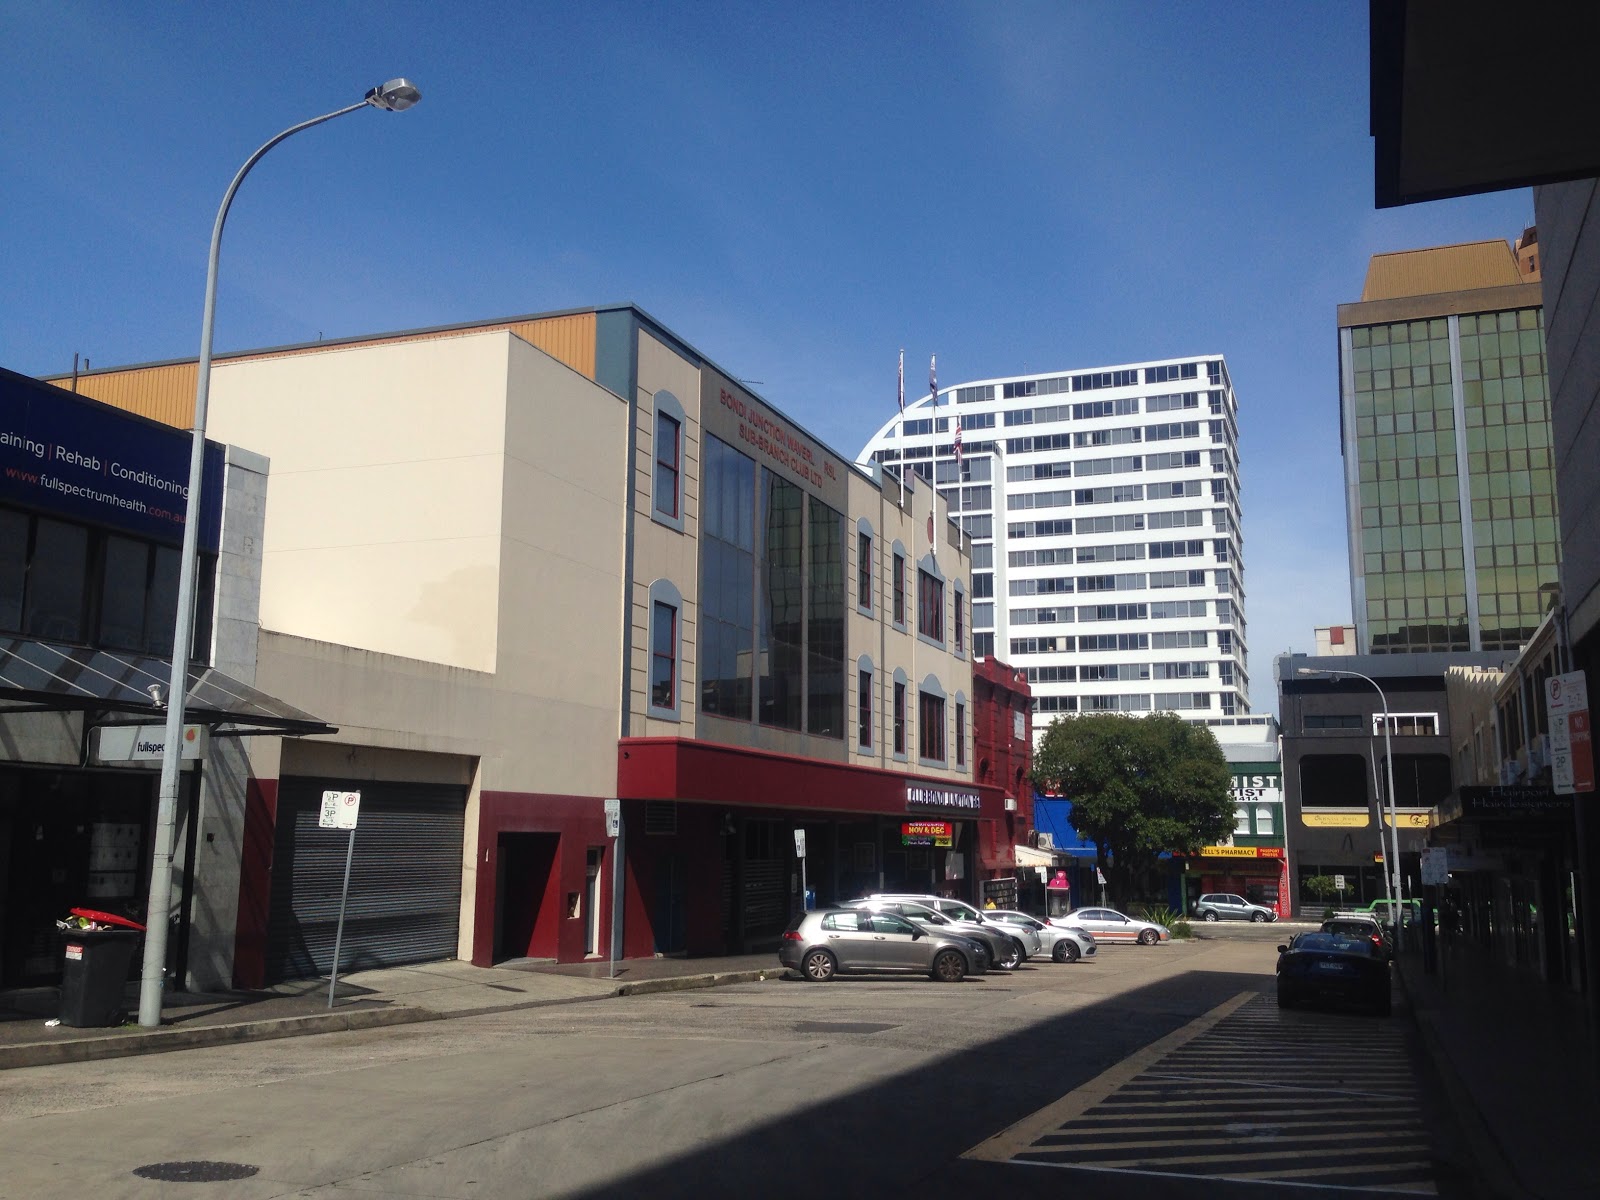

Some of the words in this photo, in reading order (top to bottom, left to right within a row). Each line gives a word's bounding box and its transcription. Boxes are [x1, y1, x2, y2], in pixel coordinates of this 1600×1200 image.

[720, 388, 747, 418] BONDI
[748, 408, 786, 446] JUNCTION
[787, 432, 815, 466] WAVERL
[823, 460, 837, 481] RSL
[55, 445, 101, 471] Rehab
[110, 462, 190, 500] Conditioning
[738, 422, 790, 467] SUB-BRANCH
[790, 456, 810, 480] CLUB
[810, 469, 823, 489] LTD
[5, 466, 187, 524] www.fullspectrumhealth.com.au
[1574, 716, 1584, 730] NO
[1556, 756, 1566, 768] 2P
[324, 809, 336, 817] 3P
[908, 826, 924, 834] NOV
[930, 826, 945, 834] DEC
